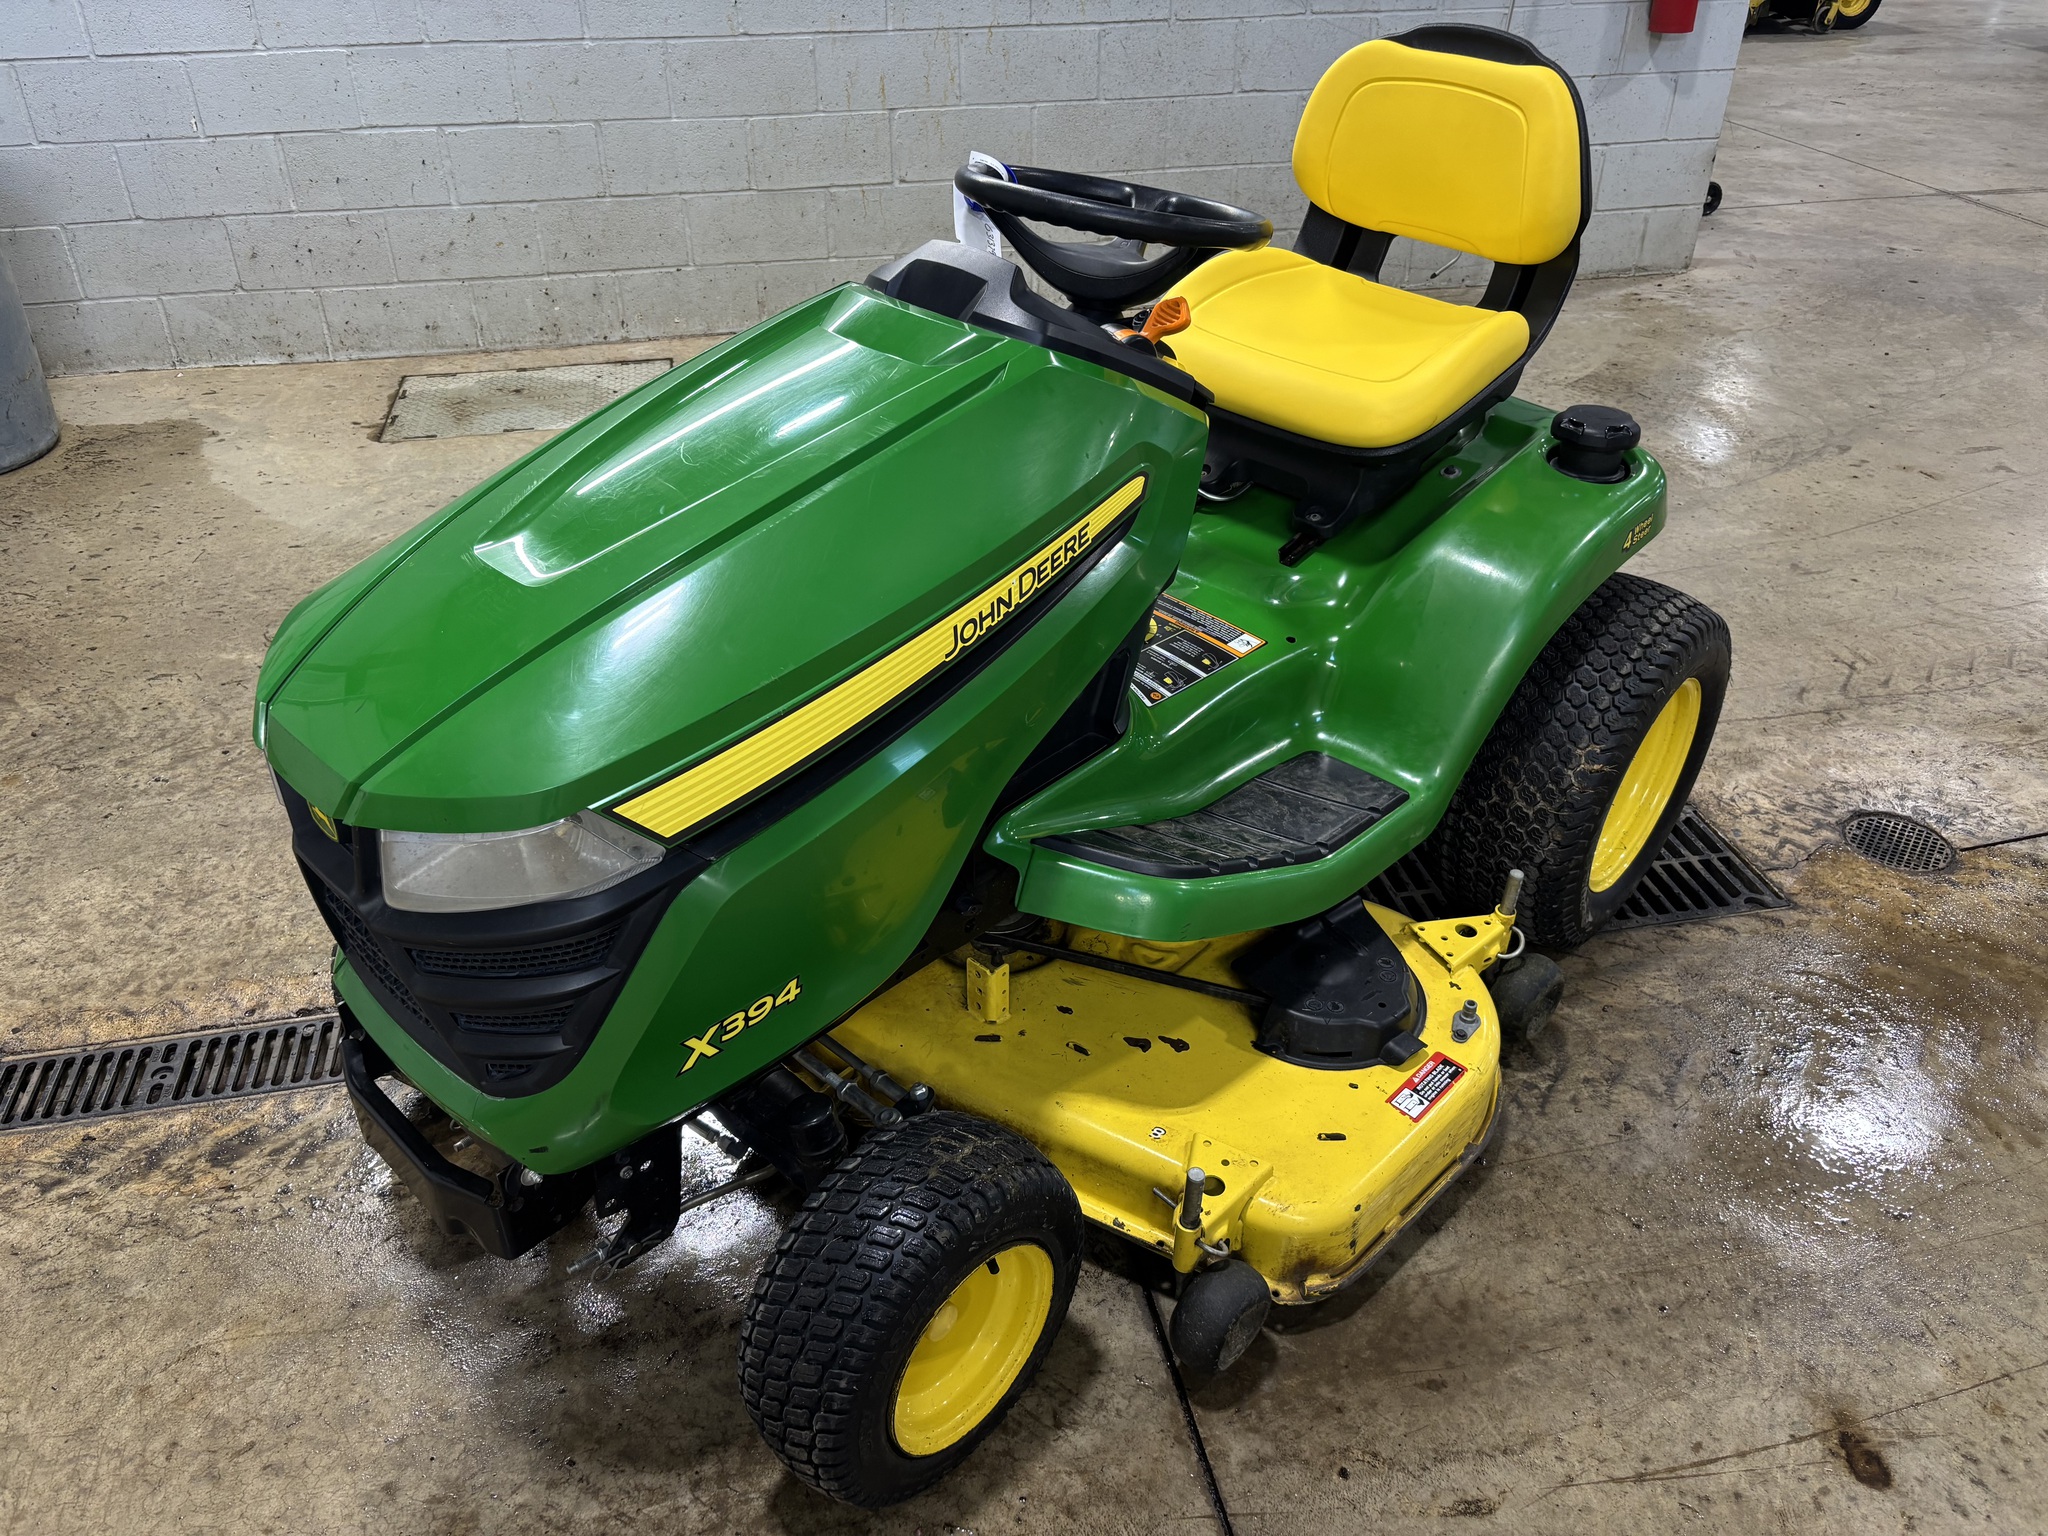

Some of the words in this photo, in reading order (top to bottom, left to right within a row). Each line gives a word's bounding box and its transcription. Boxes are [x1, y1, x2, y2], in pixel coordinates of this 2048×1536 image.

[1623, 531, 1633, 549] 4
[944, 587, 1013, 660] JOHN
[1018, 520, 1091, 602] DEERE
[677, 976, 802, 1076] X394
[1415, 1060, 1435, 1078] DANGER
